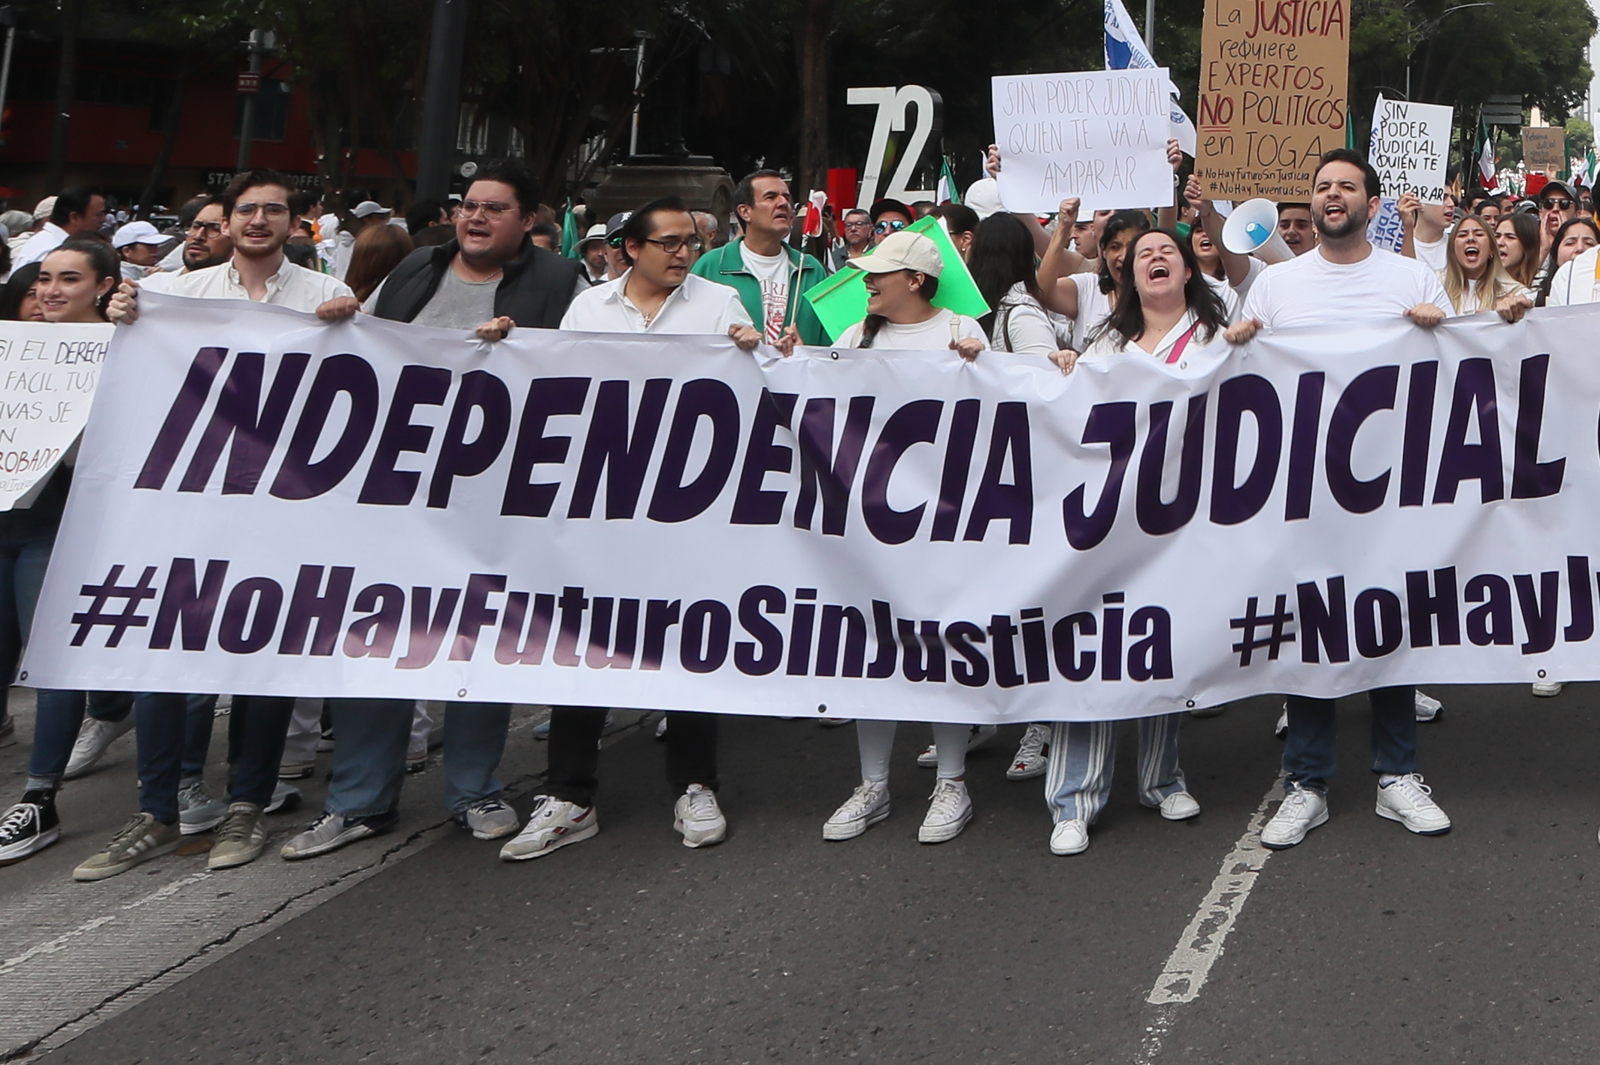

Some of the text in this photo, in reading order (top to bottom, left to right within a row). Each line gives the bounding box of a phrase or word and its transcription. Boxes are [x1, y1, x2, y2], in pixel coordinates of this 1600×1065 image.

[1219, 38, 1299, 61] requiere
[1003, 76, 1167, 116] SIN PODER JUDICIAL
[1200, 92, 1234, 126] NO
[1381, 101, 1409, 122] SIN
[1008, 118, 1149, 155] QUIEN TE VA A
[1379, 120, 1430, 140] PODER
[847, 84, 934, 208] 72
[1203, 131, 1324, 170] en TOGA
[1377, 138, 1442, 158] JUDICIAL,
[1376, 153, 1439, 171] QUIÉN TE
[1041, 155, 1137, 198] AMPARAR
[1396, 170, 1408, 182] A
[1380, 182, 1444, 202] AMPARAR
[20, 339, 49, 362] EL
[55, 341, 110, 366] DERECH
[66, 370, 96, 394] TUS
[49, 401, 73, 424] SE
[134, 346, 1034, 546] INDEPENDENCIA
[1062, 354, 1567, 552] JUDICIAL
[69, 557, 1174, 689] #NoHayFuturoSinJusticia
